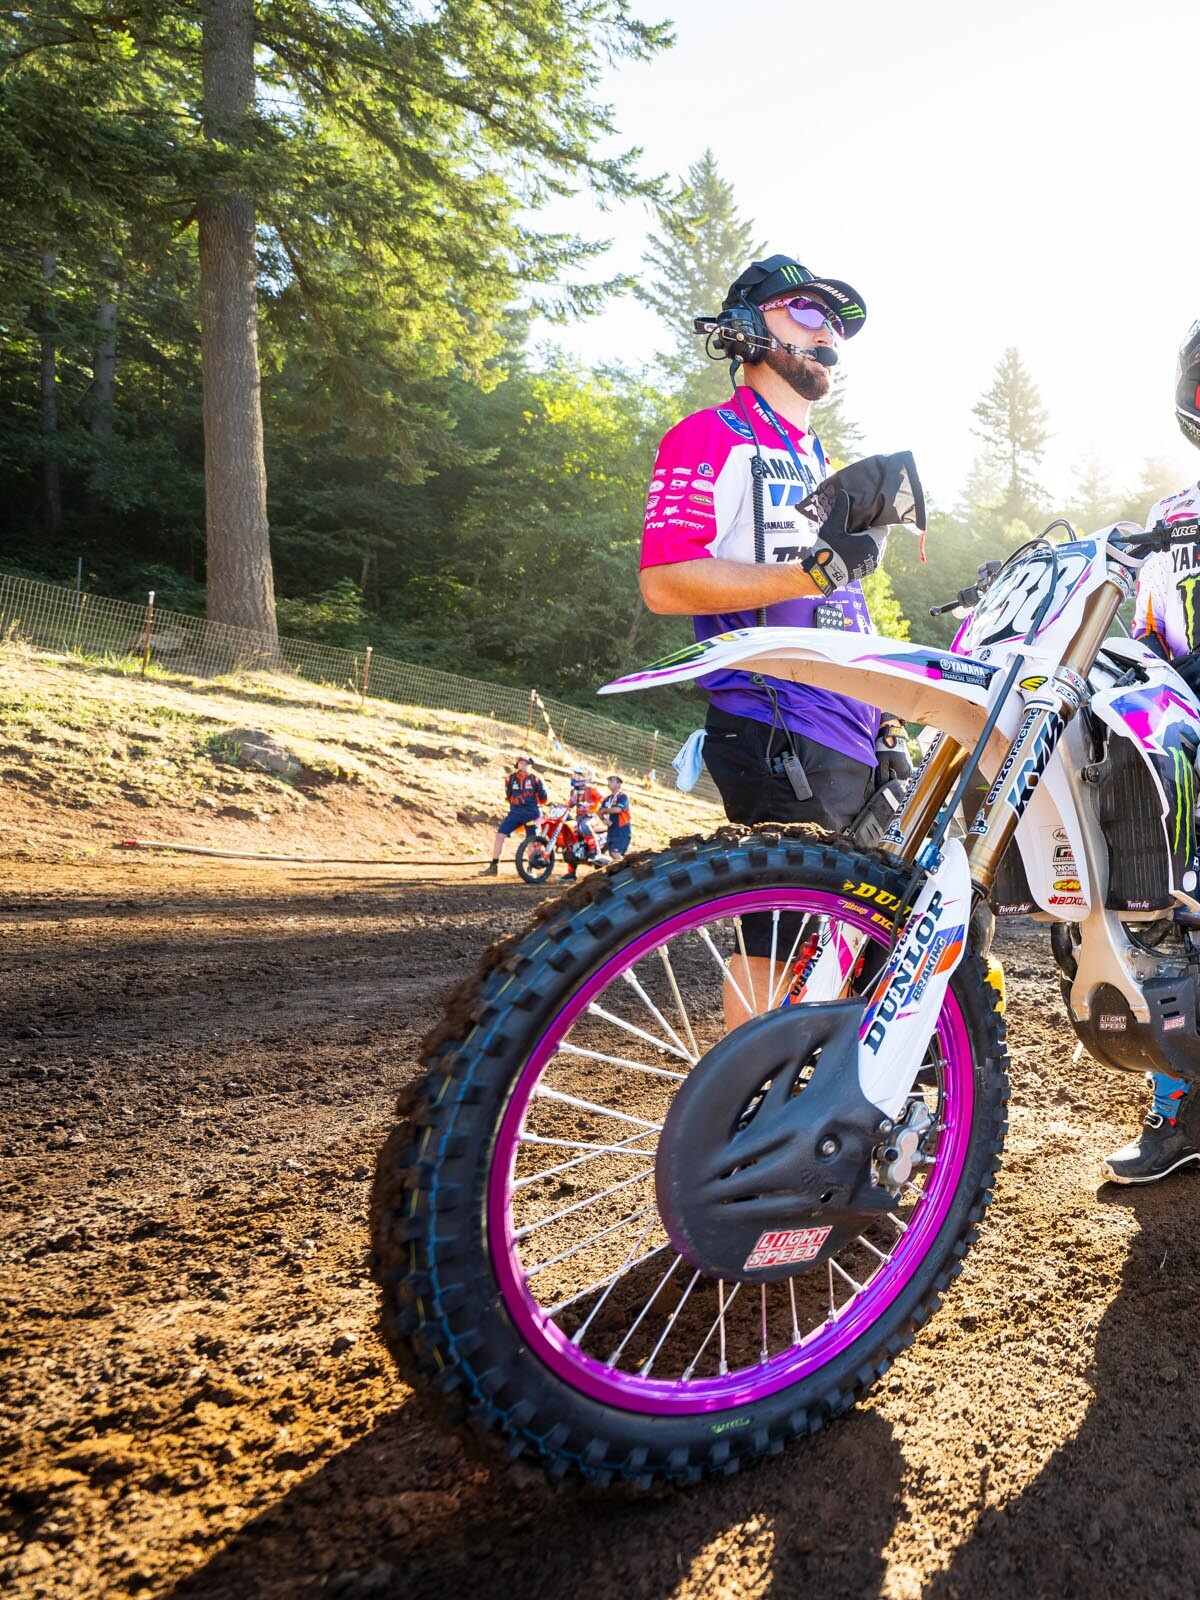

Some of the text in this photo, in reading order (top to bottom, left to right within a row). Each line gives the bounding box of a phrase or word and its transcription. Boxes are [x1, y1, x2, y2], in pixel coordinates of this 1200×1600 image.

[950, 660, 986, 677] YAMAHA
[864, 890, 944, 1056] DUNLOP
[912, 935, 946, 1004] BRAKING
[1100, 1023, 1126, 1031] SPEED
[757, 1227, 829, 1249] LIGHT
[747, 1246, 819, 1267] SPEED
